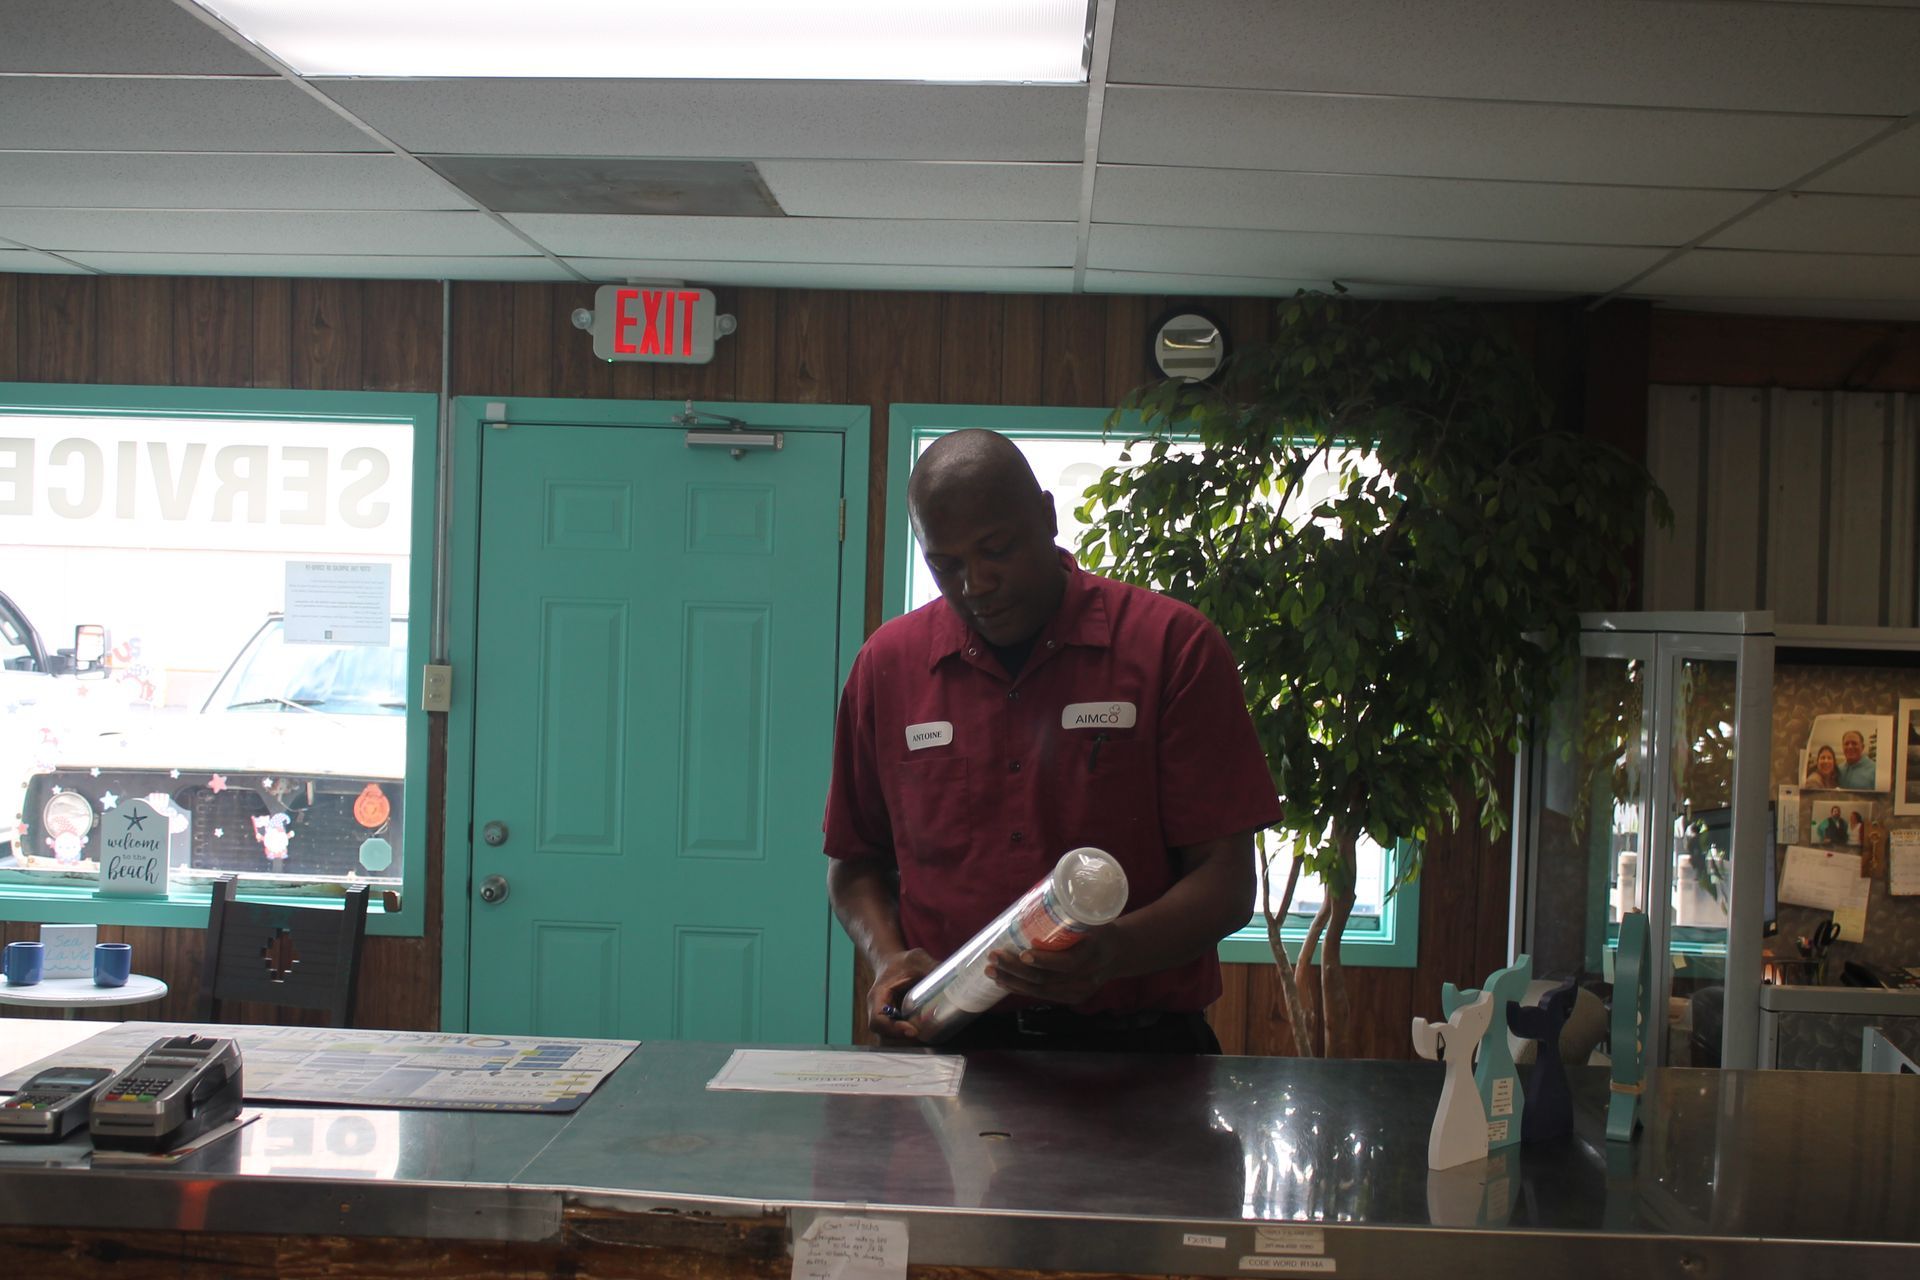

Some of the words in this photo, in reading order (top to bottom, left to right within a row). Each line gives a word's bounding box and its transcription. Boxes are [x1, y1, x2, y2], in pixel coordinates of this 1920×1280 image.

[614, 289, 700, 356] EXIT
[1075, 713, 1119, 724] AIMCO
[912, 730, 943, 743] ANTOINE
[107, 832, 160, 850] welcome
